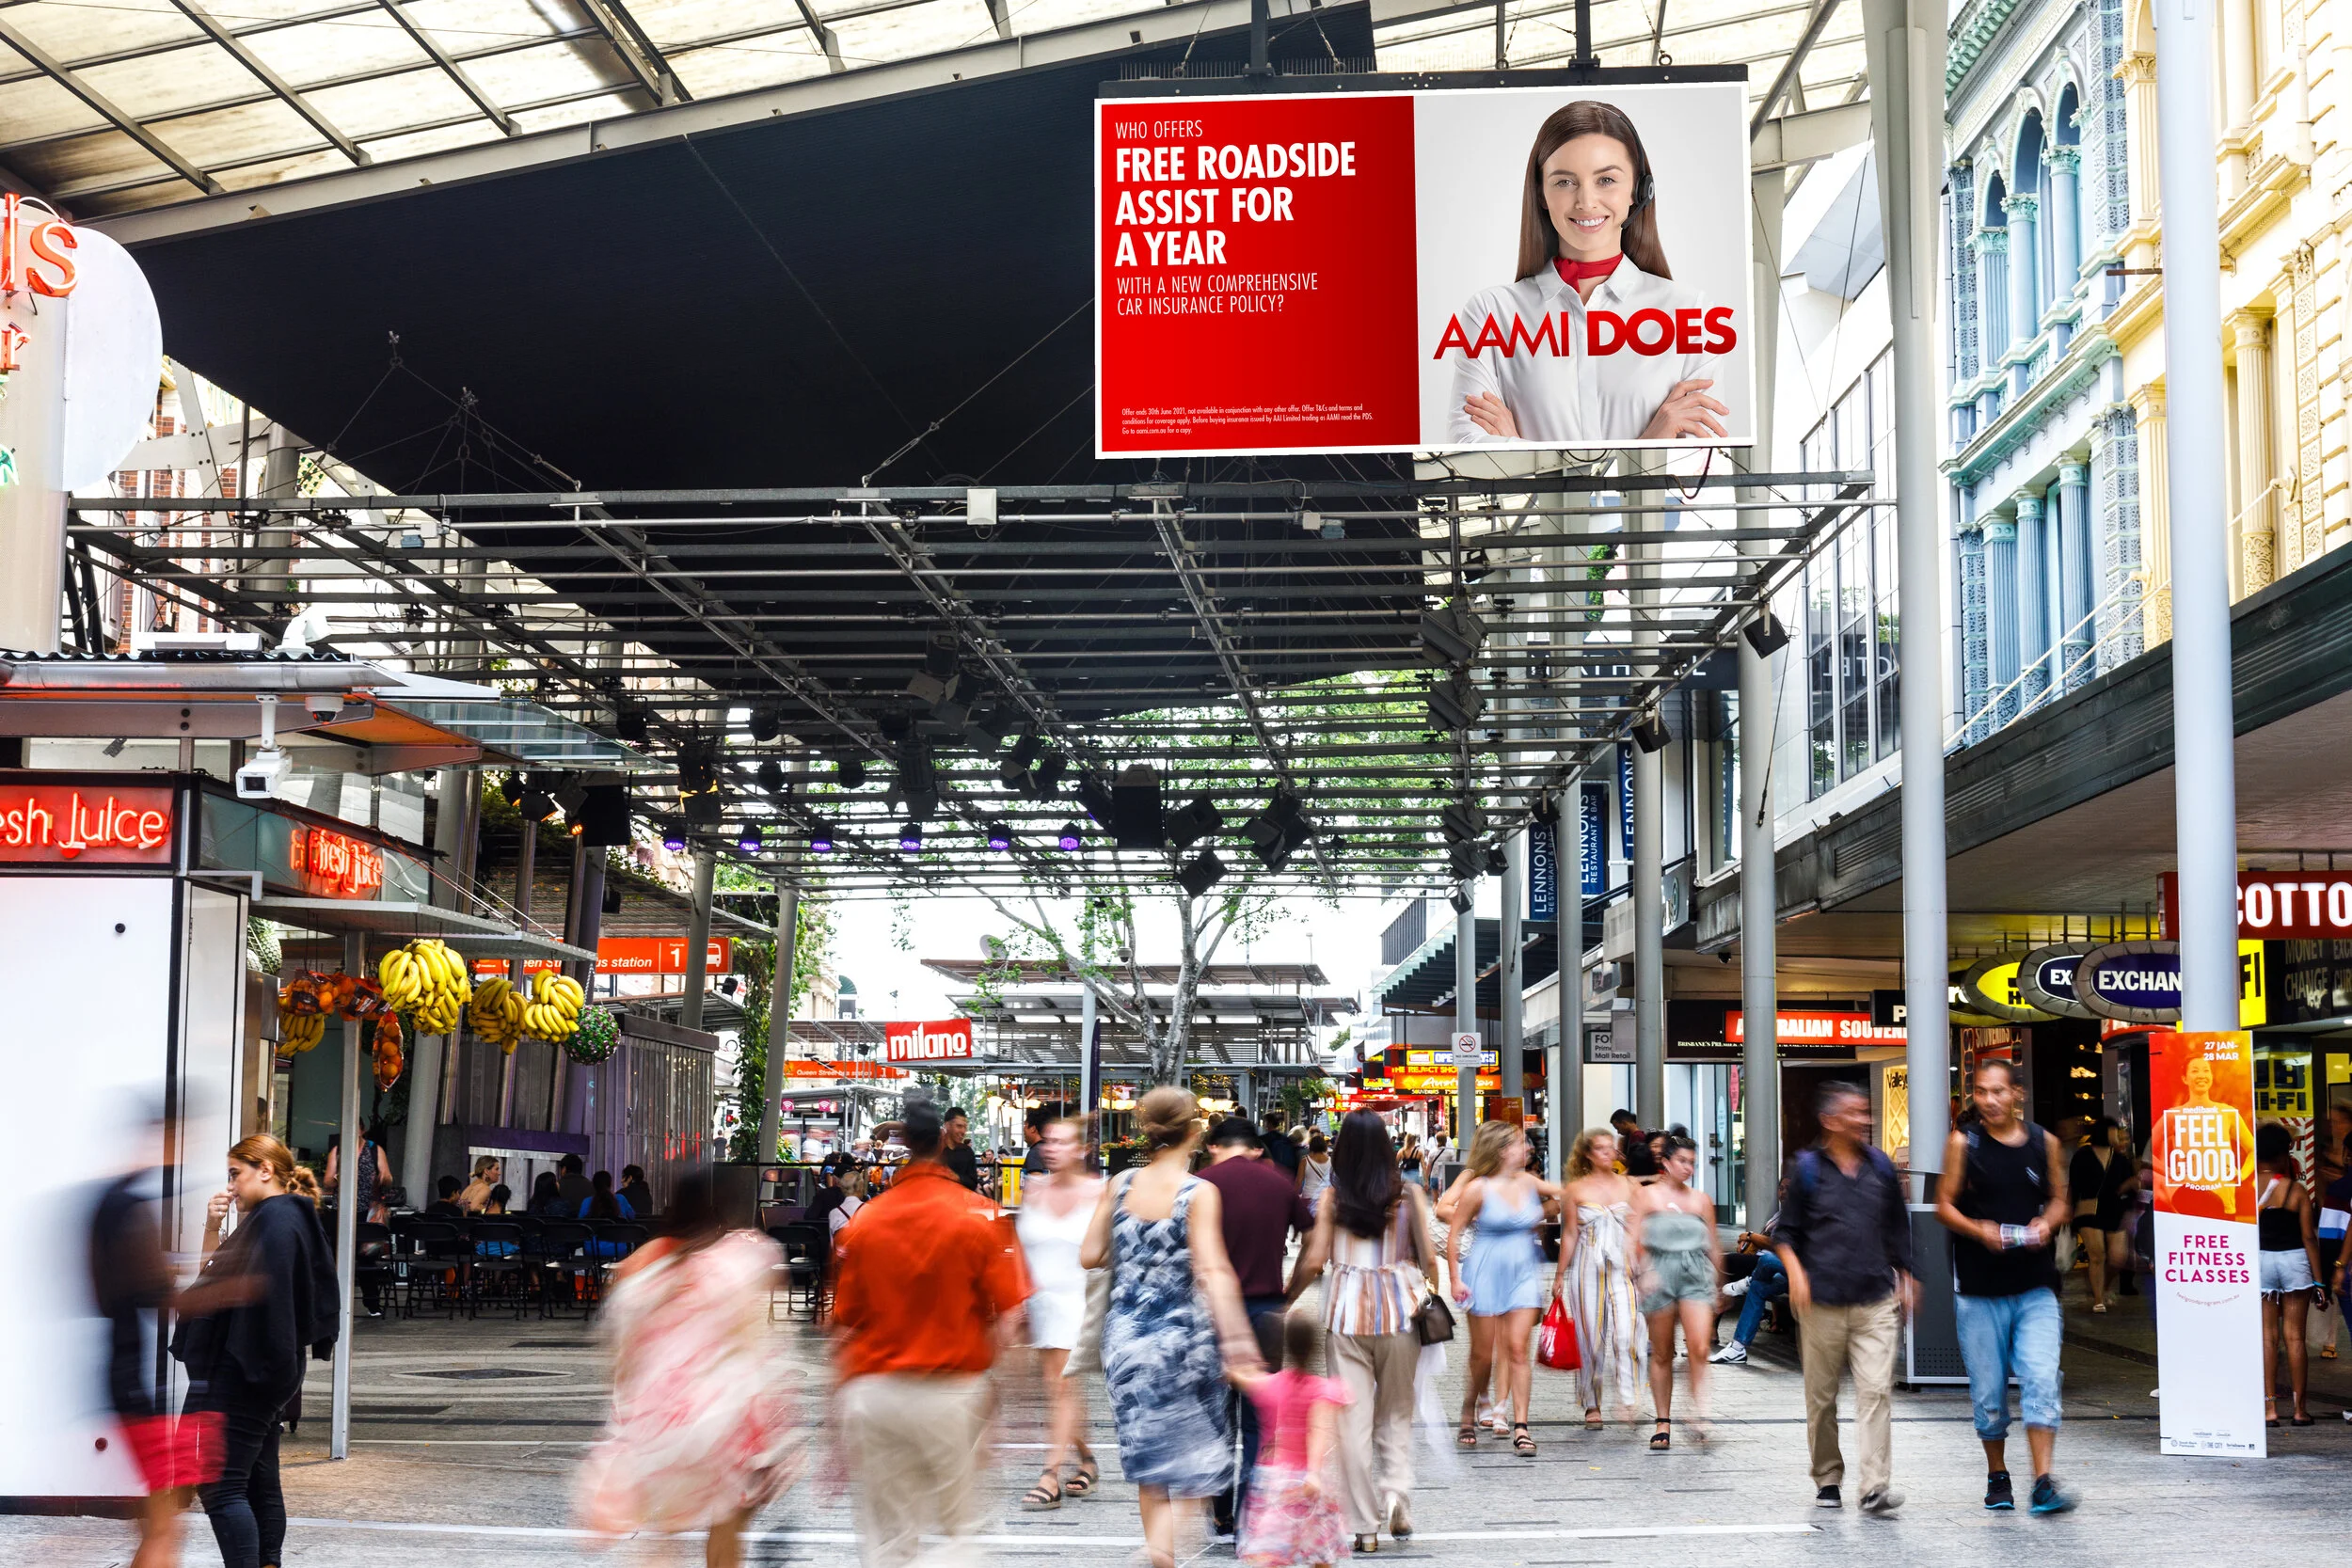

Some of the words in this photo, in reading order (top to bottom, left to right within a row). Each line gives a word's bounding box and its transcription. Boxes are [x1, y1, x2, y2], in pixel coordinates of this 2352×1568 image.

[1115, 122, 1148, 139] WHO
[1153, 119, 1203, 138] OFFERS
[1116, 146, 1185, 182] FREE
[1198, 141, 1356, 181] ROADSIDE
[1114, 188, 1219, 226] ASSIST
[1232, 186, 1295, 223] FOR
[1114, 232, 1138, 267] A
[1143, 230, 1227, 266] YEAR
[1117, 277, 1152, 294] WITH
[1157, 276, 1167, 293] A
[1171, 275, 1202, 293] NEW
[1207, 272, 1318, 293] COMPREHENSIVE
[1117, 297, 1143, 316] CAR
[1149, 295, 1223, 315] INSURANCE
[1230, 293, 1284, 313] POLICY?
[1433, 311, 1569, 360] AAMI
[1586, 307, 1737, 356] DOES
[1121, 407, 1135, 416] Offer
[1136, 407, 1147, 416] ends
[1172, 406, 1186, 416] 2021,
[1187, 406, 1196, 415] not
[1197, 406, 1218, 415] available
[1225, 405, 1251, 415] conjunction
[1263, 405, 1273, 415] any
[1274, 404, 1287, 413] other
[1287, 404, 1301, 413] offer.
[1301, 404, 1314, 412] Offer
[1353, 403, 1363, 411] and
[1121, 417, 1146, 425] conditions
[1177, 417, 1191, 425] apply.
[1209, 415, 1226, 425] buying
[1226, 415, 1249, 423] insurance
[1249, 414, 1265, 422] issued
[1265, 414, 1272, 423] by
[1282, 413, 1301, 421] Limited
[1301, 413, 1319, 423] trading
[1341, 412, 1352, 420] read
[1353, 412, 1361, 420] the
[1361, 412, 1374, 420] PDS.
[1121, 427, 1130, 436] Go
[1136, 426, 1167, 435] aami.com.au
[1180, 427, 1192, 436] copy.
[1590, 794, 1598, 815] BAR
[0, 798, 53, 846] sh
[1590, 825, 1598, 884] RESTAURANT
[1534, 832, 1548, 913] LENNONS
[2237, 881, 2352, 927] OTTO
[611, 956, 652, 968] station
[670, 947, 680, 968] 1
[2284, 939, 2324, 965] MONEY
[2284, 967, 2328, 1002] CHANGE
[1595, 1034, 1613, 1044] FO
[1735, 1019, 1833, 1038] ARALIAN
[890, 1022, 967, 1060] milano
[2204, 1041, 2216, 1050] 27
[2217, 1041, 2239, 1051] JAN-
[1435, 1053, 1454, 1064] OPE
[2203, 1053, 2215, 1061] 28
[2216, 1053, 2239, 1061] MAR
[2182, 1105, 2219, 1115] medibank
[2174, 1114, 2231, 1148] FEEL
[2169, 1148, 2236, 1182] GOOD
[2185, 1182, 2222, 1192] PROGRAM
[2184, 1235, 2229, 1249] FREE
[2168, 1252, 2246, 1265] FITNESS
[2165, 1269, 2250, 1284] CLASSES
